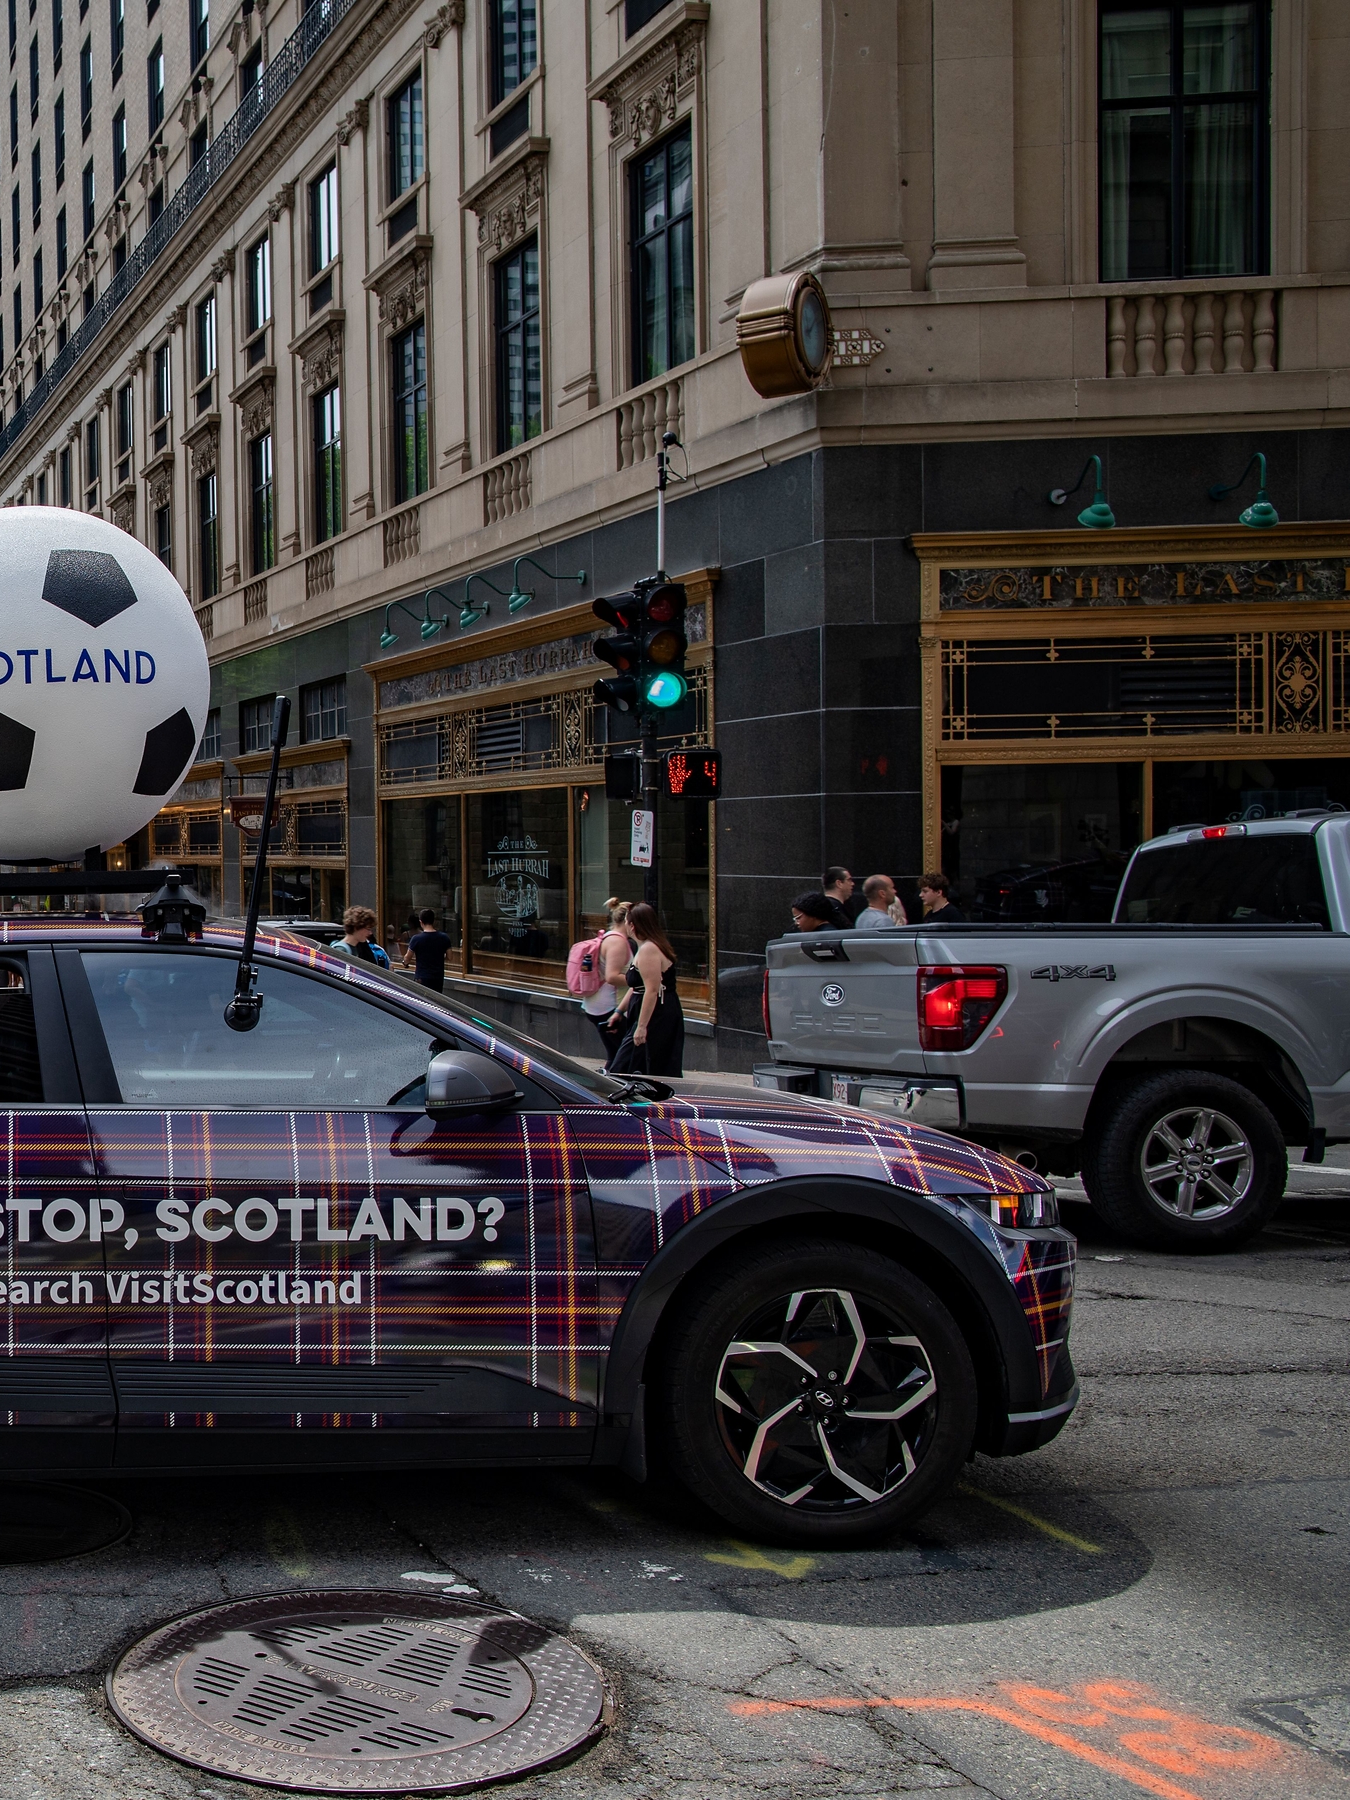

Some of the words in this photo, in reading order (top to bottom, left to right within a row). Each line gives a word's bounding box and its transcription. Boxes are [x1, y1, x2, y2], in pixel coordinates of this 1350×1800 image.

[1032, 574, 1140, 600] THE
[1175, 570, 1312, 597] LAST
[444, 672, 472, 690] THE
[479, 660, 518, 684] LAST
[523, 640, 593, 674] HURRAH
[704, 761, 717, 787] 4
[511, 841, 524, 849] THE
[488, 858, 509, 879] LAST
[511, 858, 549, 879] HURRAH
[155, 1197, 505, 1242] SCOTLAND?
[103, 1271, 362, 1305] VisitScotland
[217, 1721, 248, 1739] MADE
[273, 1740, 301, 1753] USA
